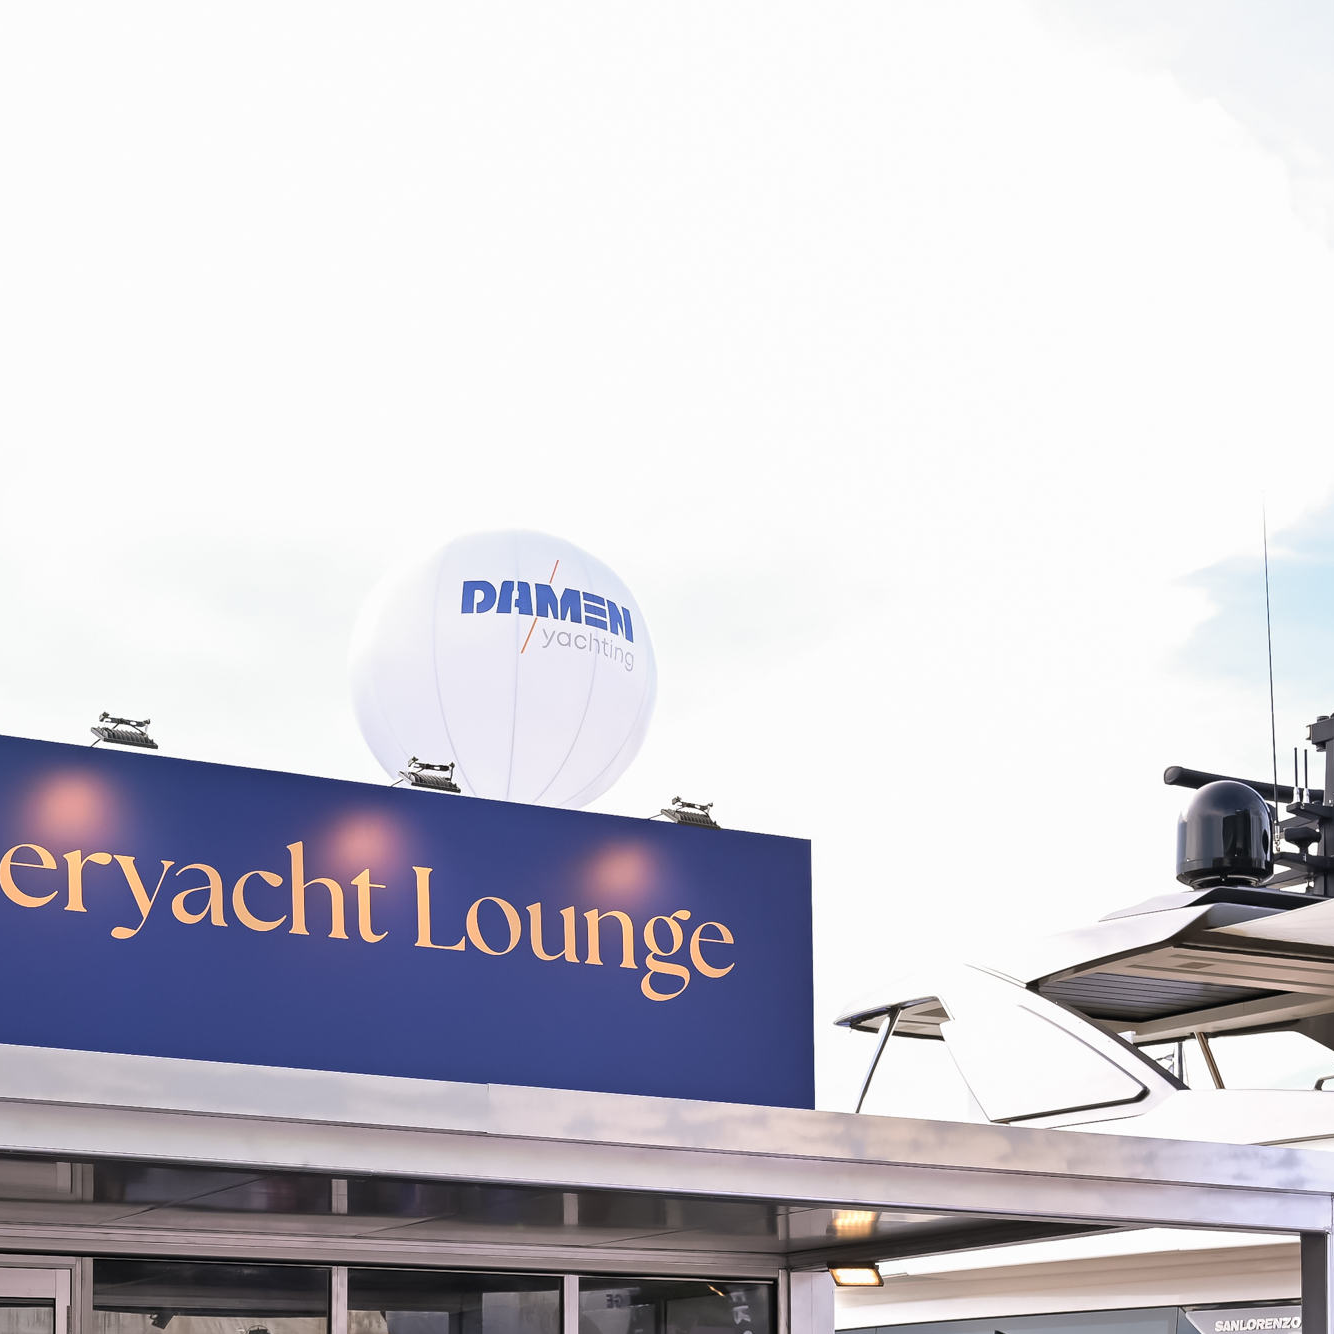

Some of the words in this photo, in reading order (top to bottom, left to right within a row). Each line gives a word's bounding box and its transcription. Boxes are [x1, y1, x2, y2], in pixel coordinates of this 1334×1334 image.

[461, 580, 634, 643] DAMEN
[542, 628, 634, 672] yachting
[412, 866, 735, 1002] Lounge
[1214, 1316, 1302, 1332] SANLORENZO
